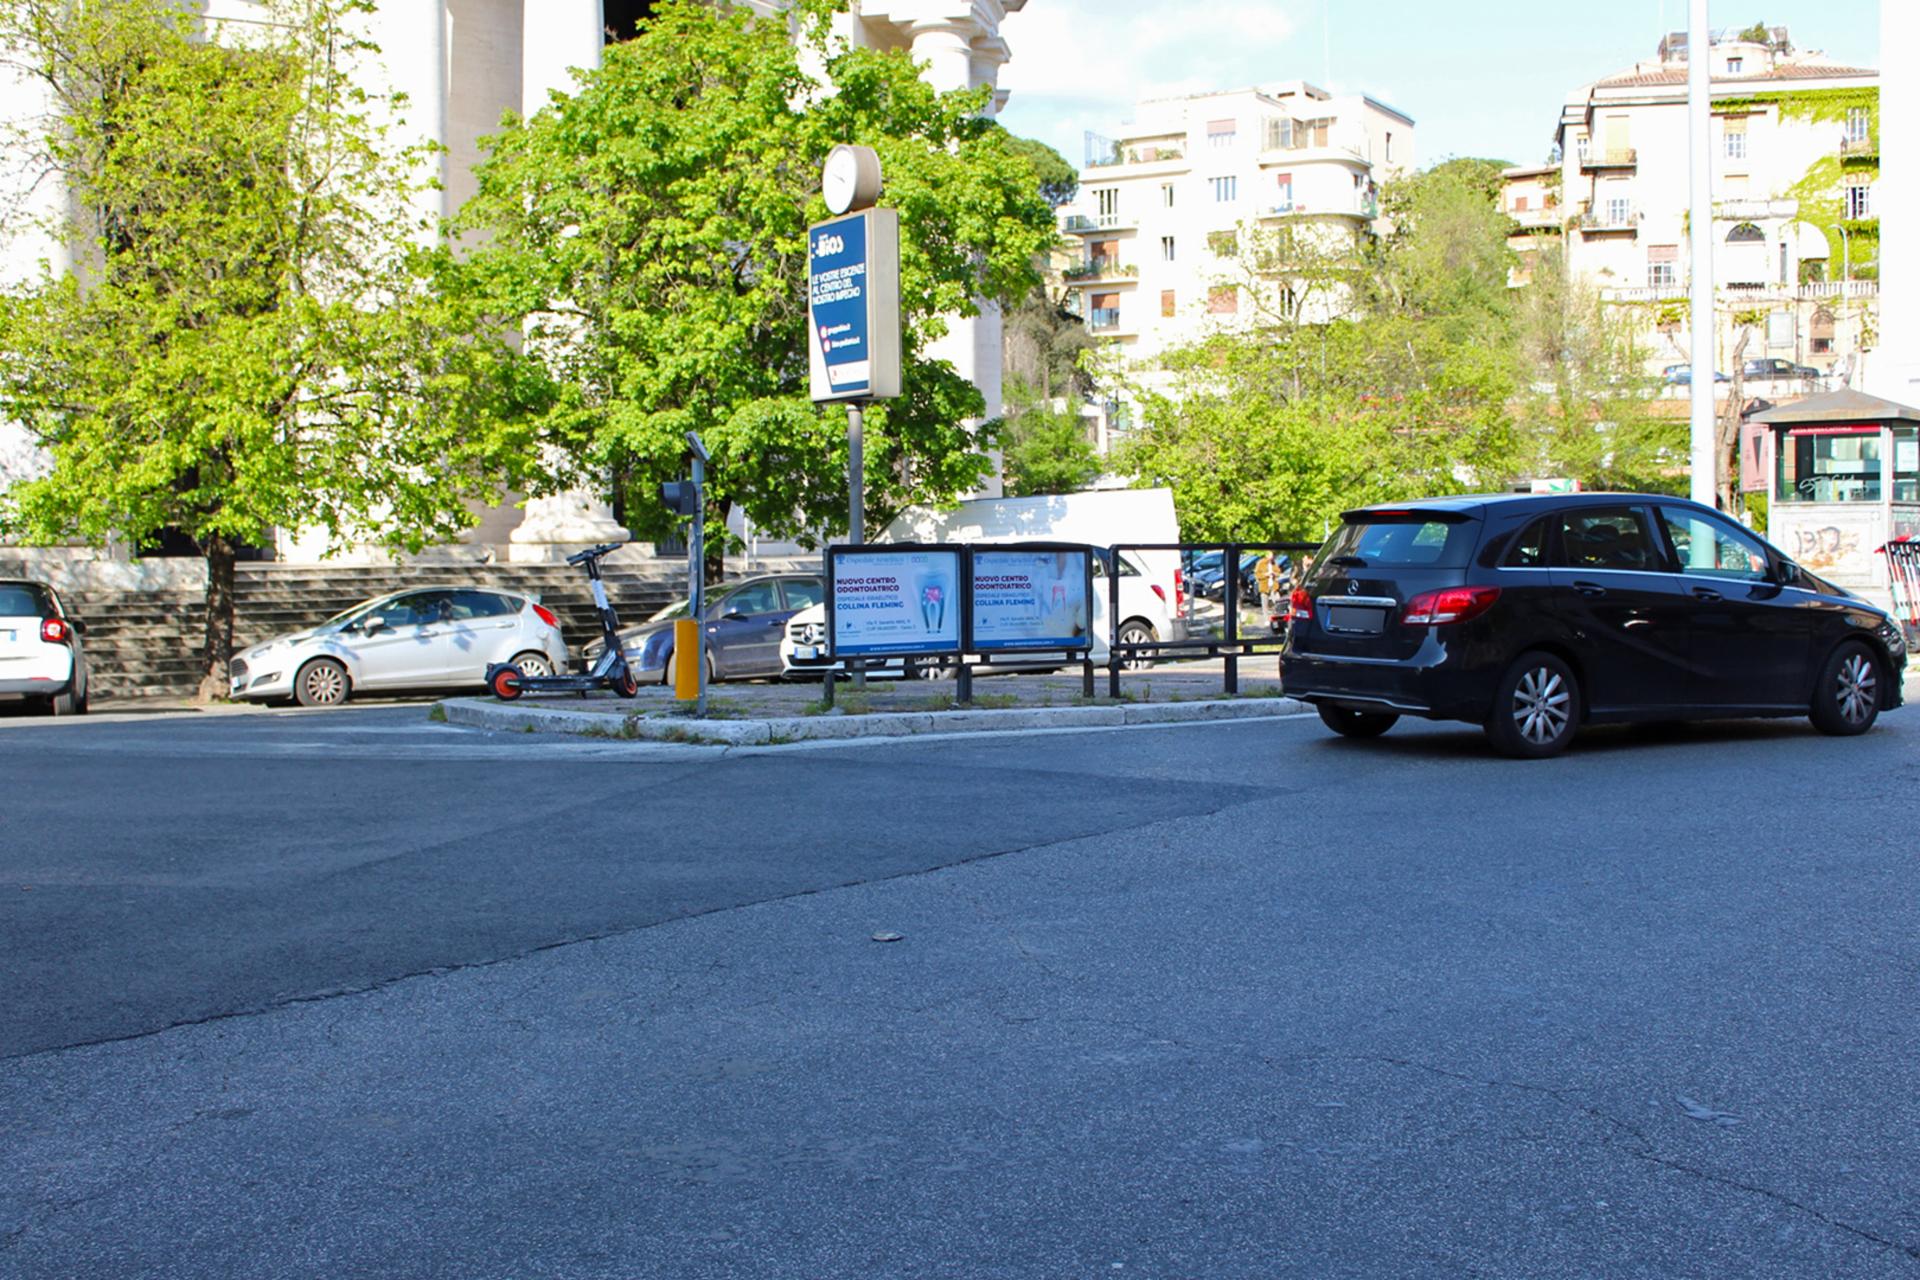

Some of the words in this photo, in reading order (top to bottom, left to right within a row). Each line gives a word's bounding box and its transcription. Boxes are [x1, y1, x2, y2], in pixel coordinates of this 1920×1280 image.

[820, 269, 840, 282] VOSTRE
[820, 280, 842, 293] CENTRO
[812, 292, 835, 305] NOSTRO
[836, 585, 900, 593] ODONTOIATRICO
[975, 582, 1032, 590] ODONTOIATRICO
[837, 602, 870, 610] COLLINA
[871, 601, 904, 609] FLEMING
[975, 599, 1005, 607] COLLINA
[1005, 598, 1036, 606] FLEMING
